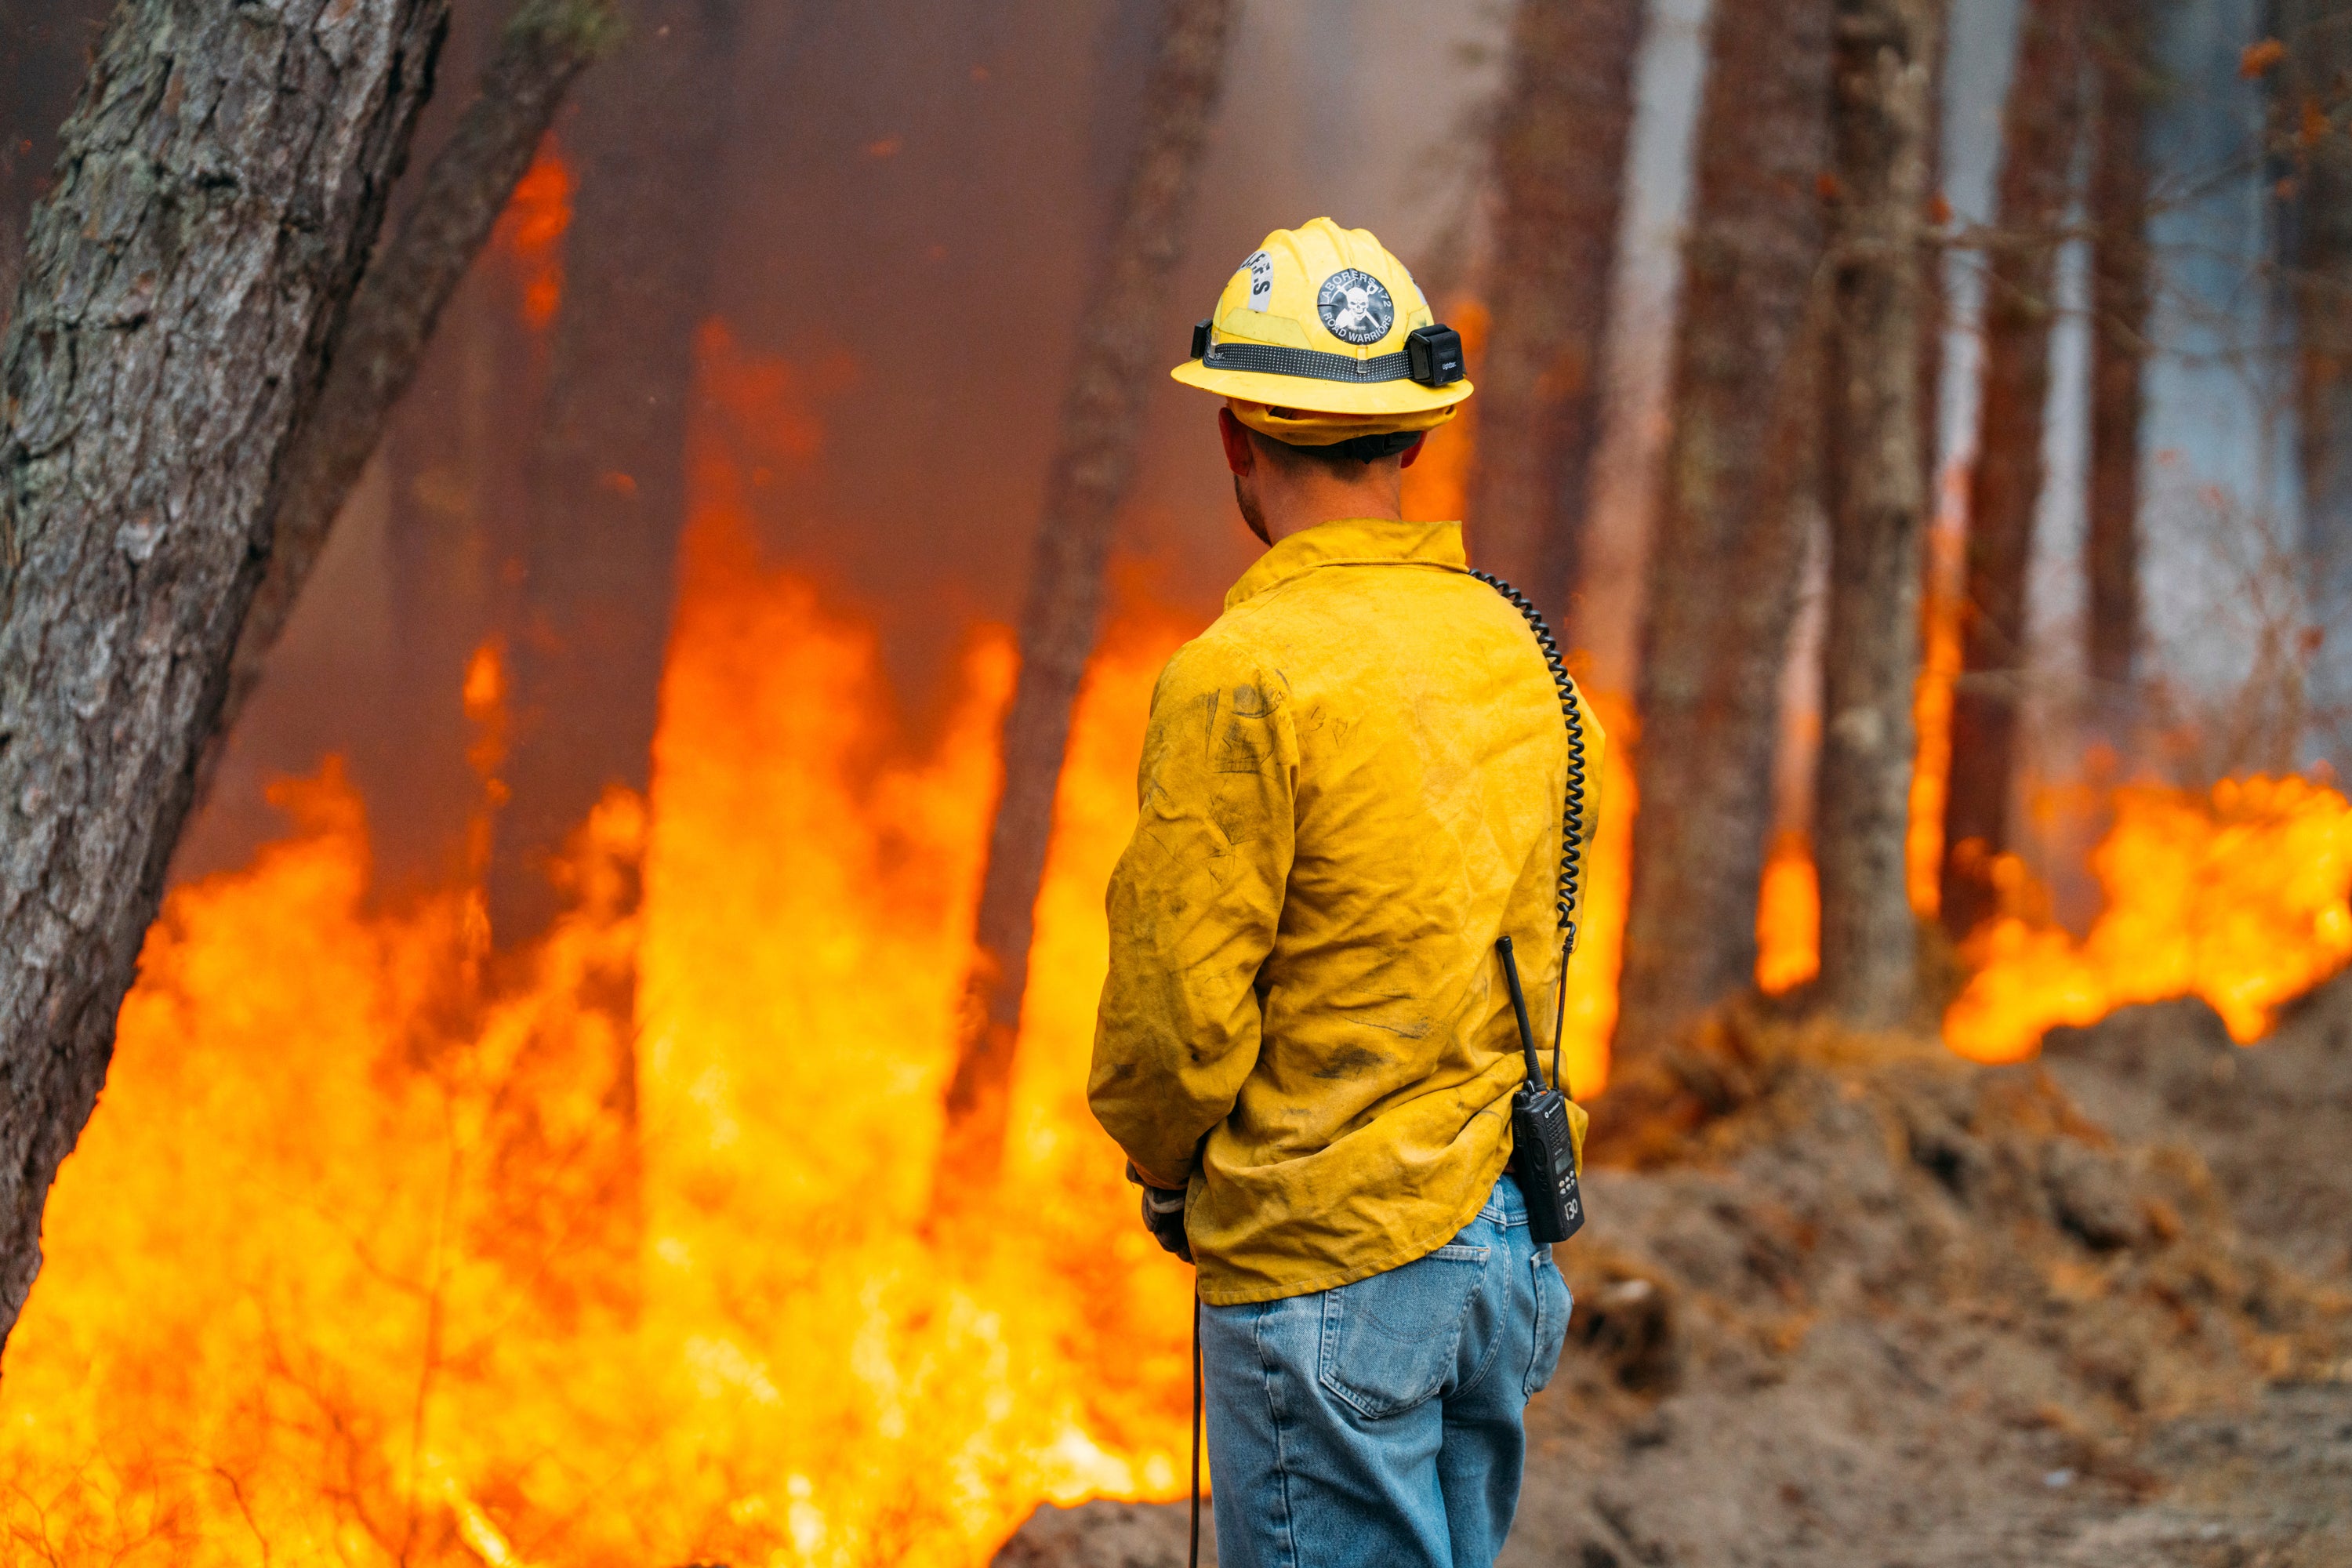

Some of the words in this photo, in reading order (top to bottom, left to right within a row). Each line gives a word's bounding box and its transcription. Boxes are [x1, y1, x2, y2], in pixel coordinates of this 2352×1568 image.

[1320, 270, 1375, 304] LABORERS
[1377, 287, 1392, 307] 172
[1323, 313, 1346, 337] ROAD
[1348, 314, 1391, 343] WARRIORS
[1564, 1198, 1578, 1221] 130
